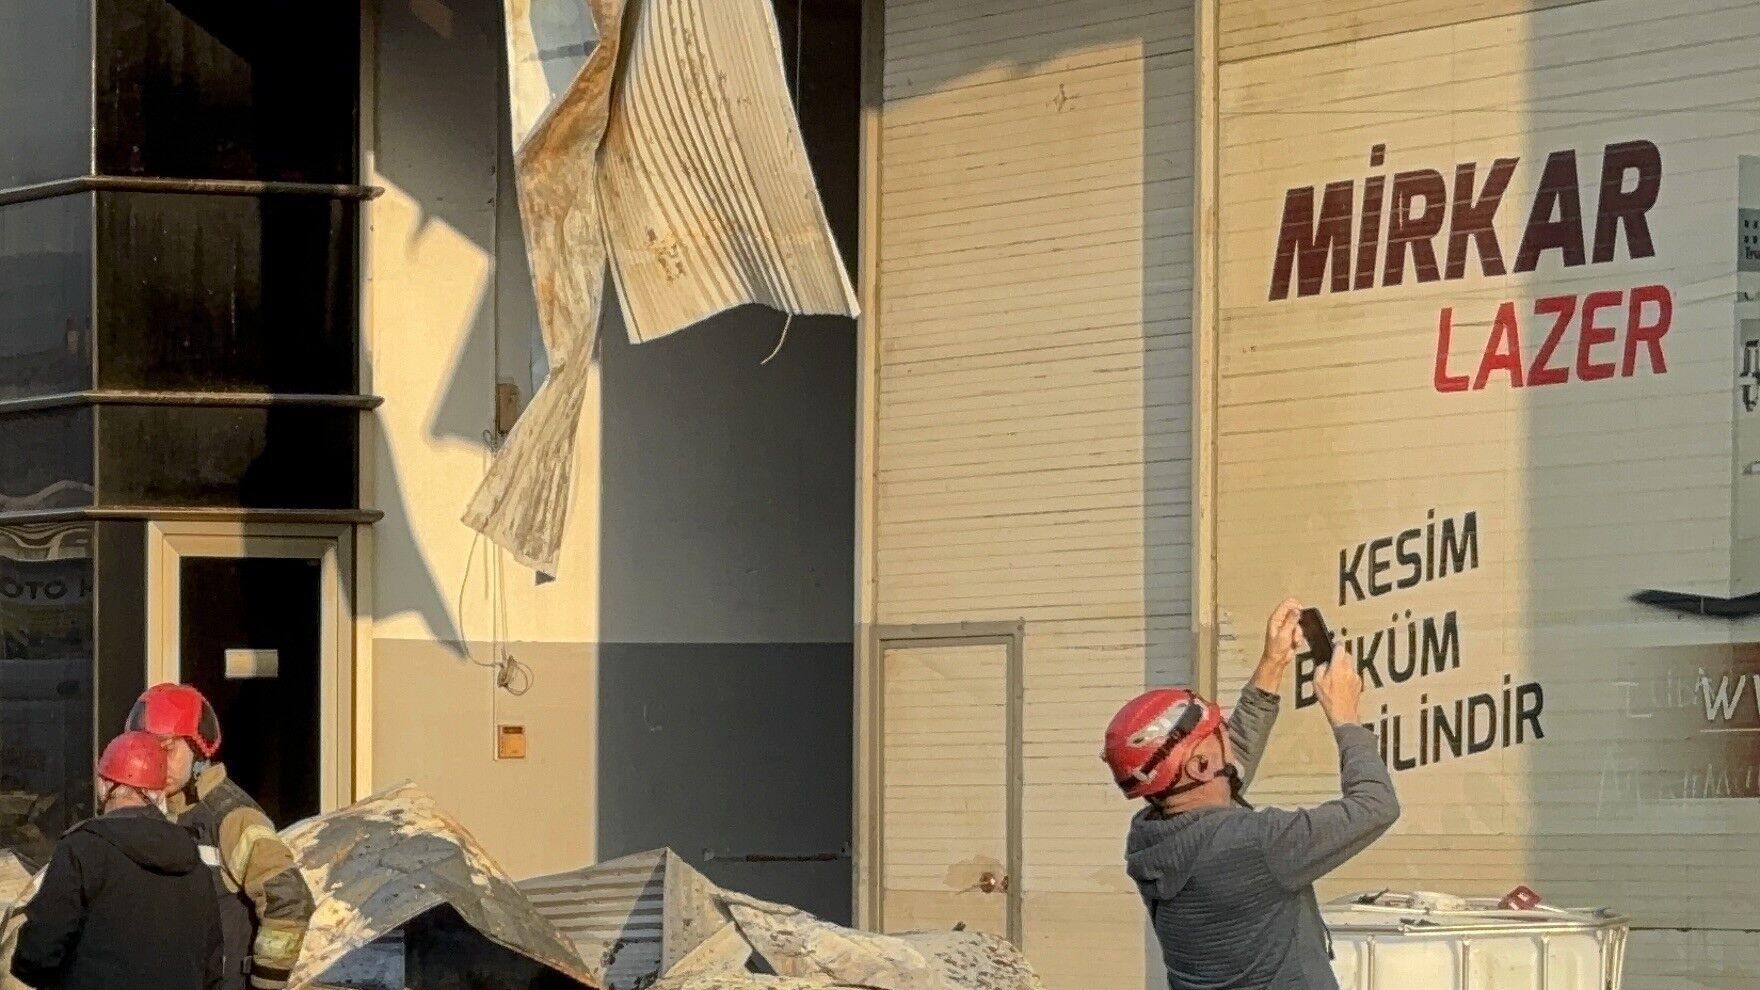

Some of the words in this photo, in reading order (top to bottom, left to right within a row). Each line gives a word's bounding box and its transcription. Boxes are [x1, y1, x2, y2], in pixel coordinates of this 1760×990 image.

[1268, 139, 1663, 302] MİRKAR
[1434, 284, 1673, 394] LAZER
[1338, 508, 1480, 607] KESİM
[1294, 608, 1461, 710] BKÜM
[1342, 673, 1546, 772] İLİNDİR
